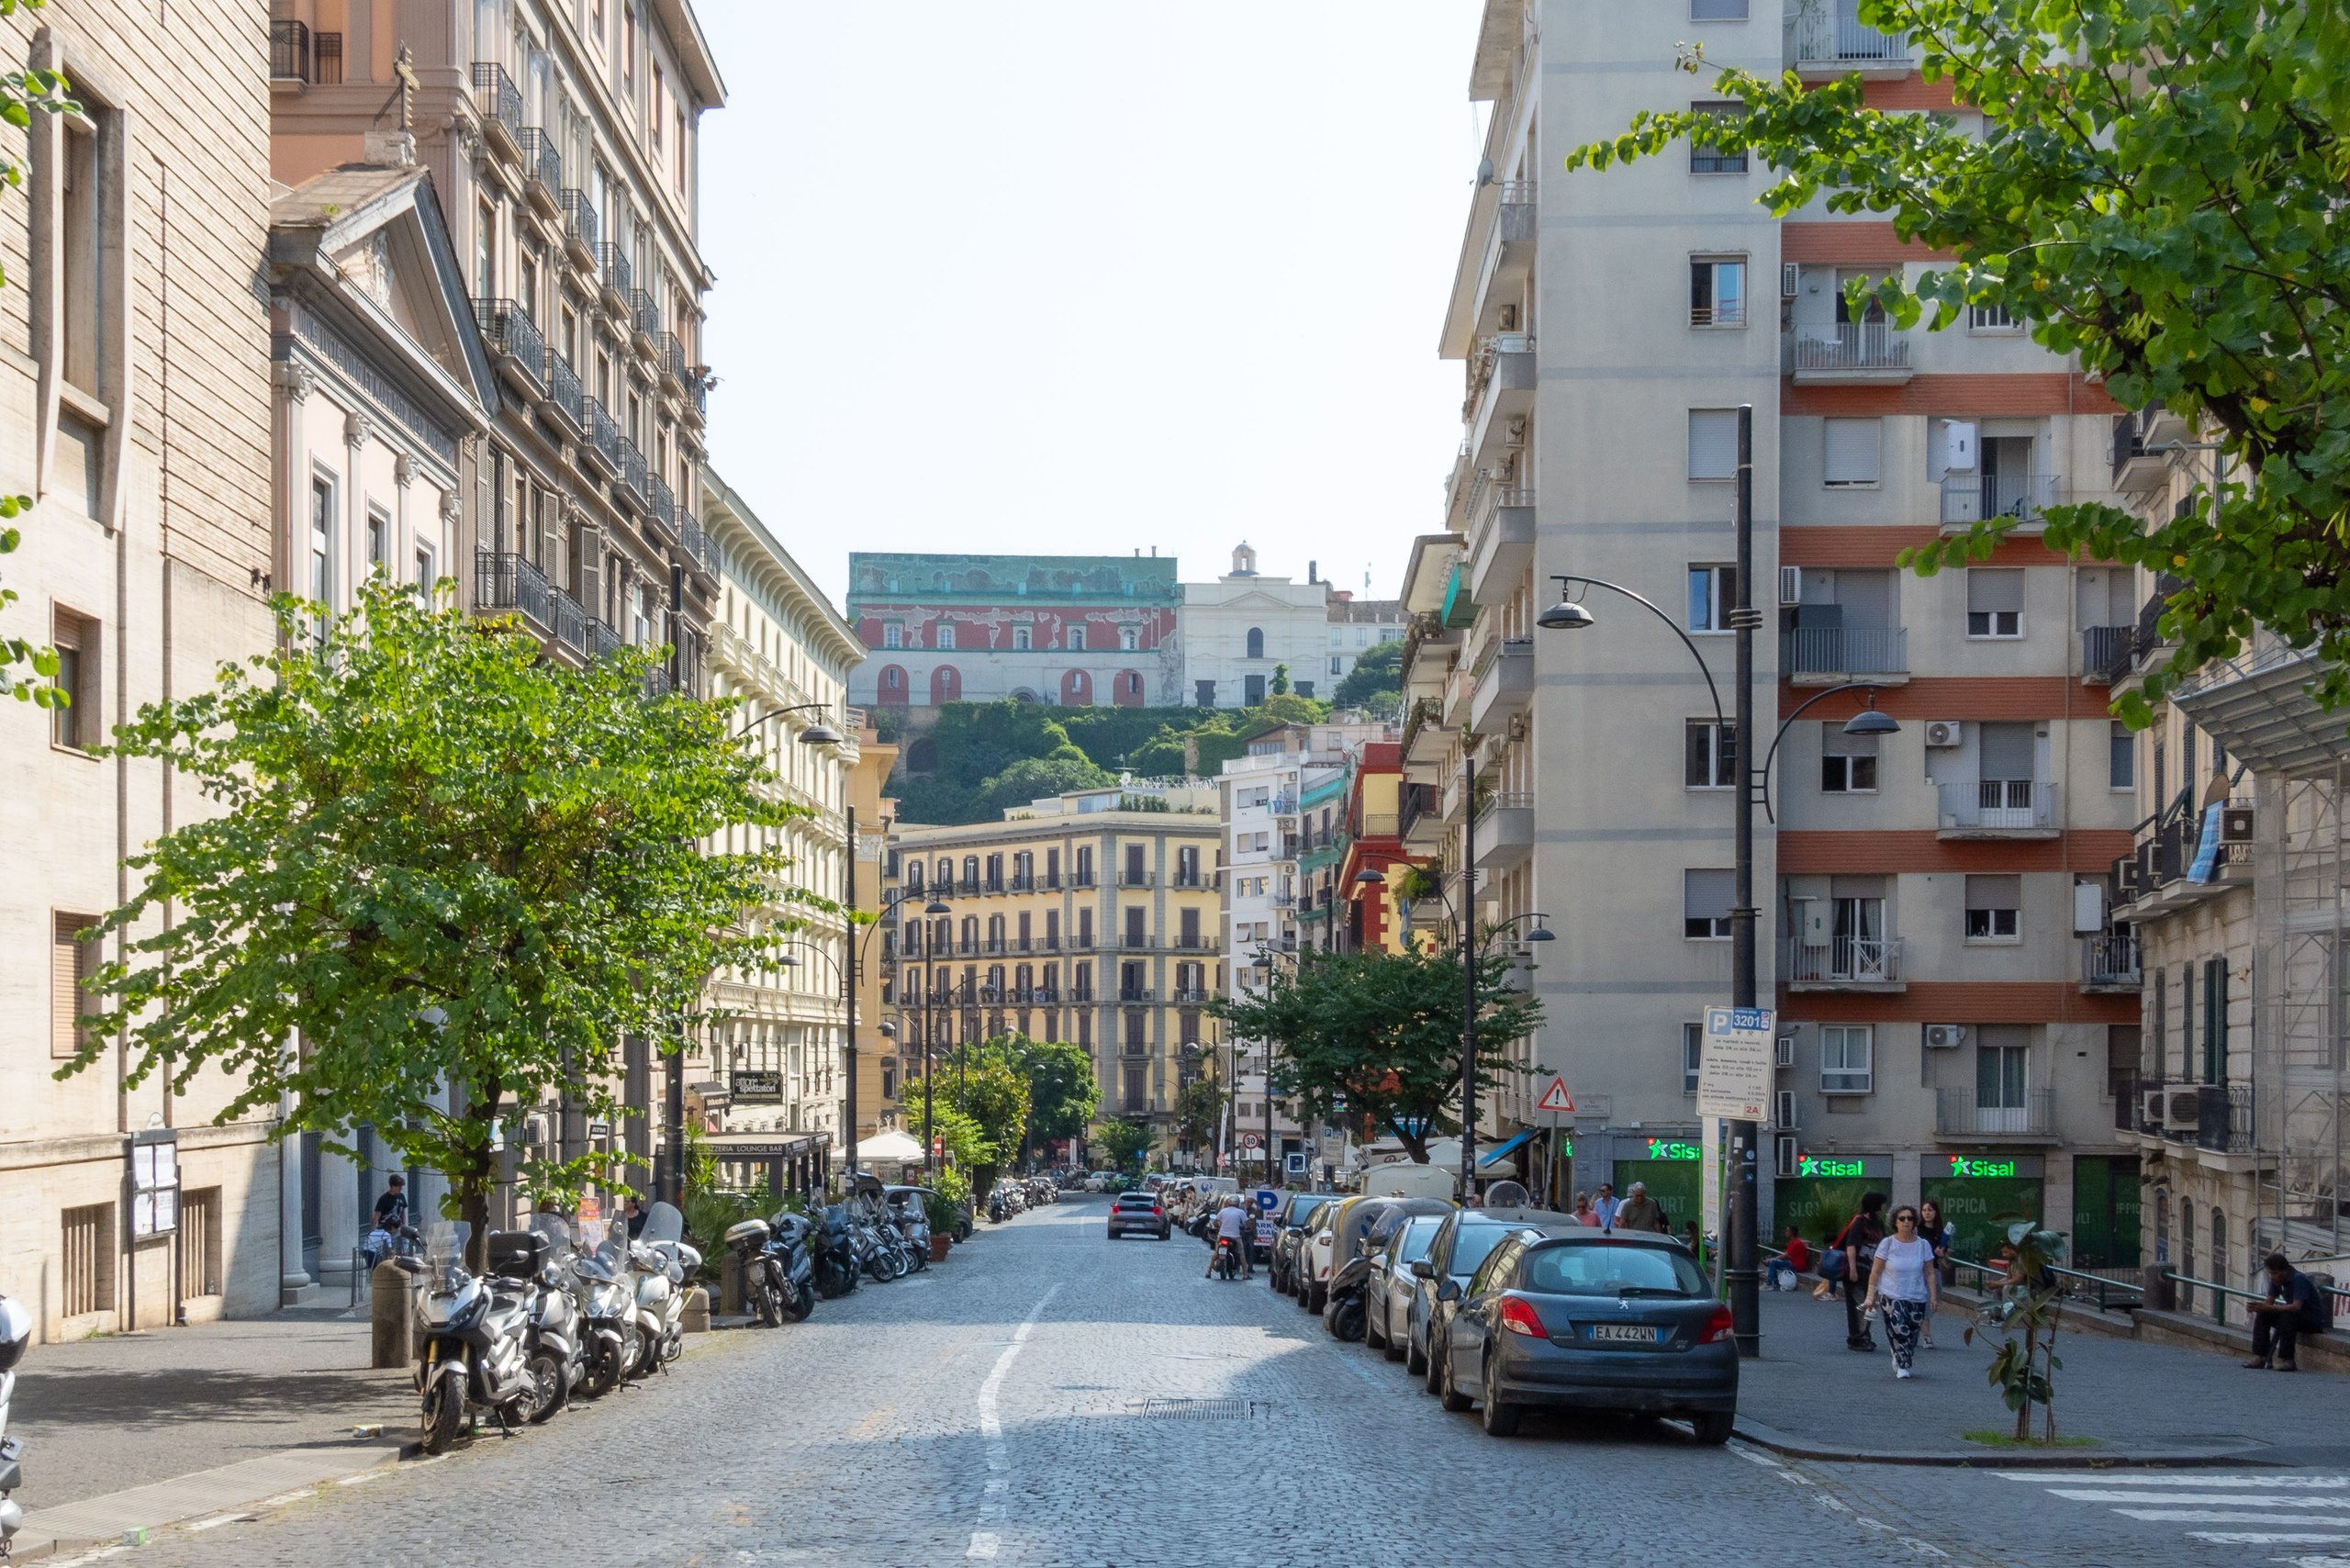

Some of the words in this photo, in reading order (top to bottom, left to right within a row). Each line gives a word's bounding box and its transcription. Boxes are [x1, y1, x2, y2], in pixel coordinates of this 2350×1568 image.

[1713, 1014, 1728, 1032] P
[1734, 1014, 1760, 1027] 3201
[739, 1083, 777, 1093] spettatori
[1746, 1105, 1759, 1114] 2A
[737, 1144, 767, 1152] LOUNGE
[768, 1144, 783, 1152] BAR
[1819, 1159, 1863, 1177] Sisal
[1971, 1160, 2015, 1177] Sisal
[1943, 1197, 1987, 1214] IPPICA
[1595, 1325, 1611, 1339] EA
[1616, 1325, 1655, 1341] 442WN
